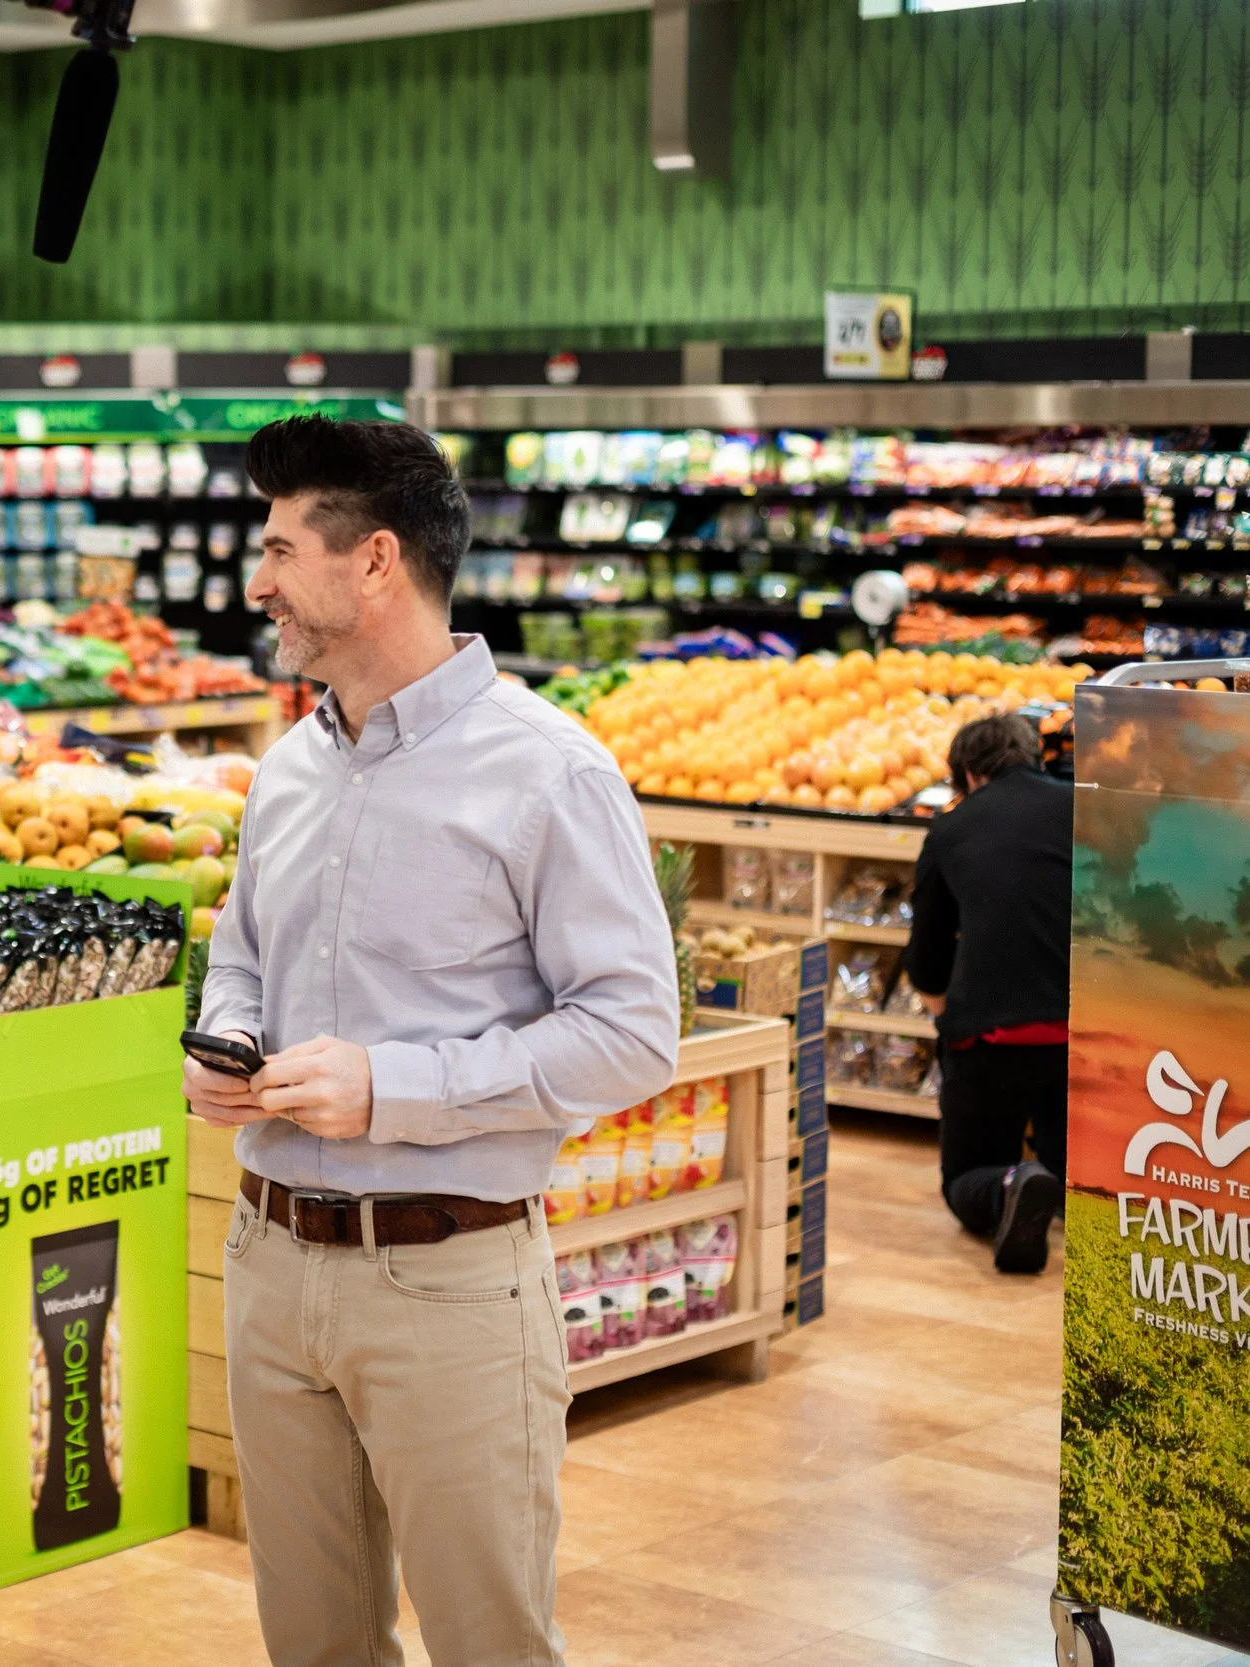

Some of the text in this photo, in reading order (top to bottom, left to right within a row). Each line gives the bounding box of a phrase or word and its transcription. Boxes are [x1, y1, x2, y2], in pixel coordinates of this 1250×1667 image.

[26, 1147, 58, 1174] OF
[65, 1127, 162, 1169] PROTEIN
[21, 1180, 57, 1213] OF
[68, 1157, 170, 1204] REGRET
[1152, 1165, 1220, 1192] HARRIS
[42, 1286, 107, 1316] Wonderful
[1134, 1307, 1229, 1344] FRESHNESS
[64, 1317, 91, 1512] PISTACHIOS
